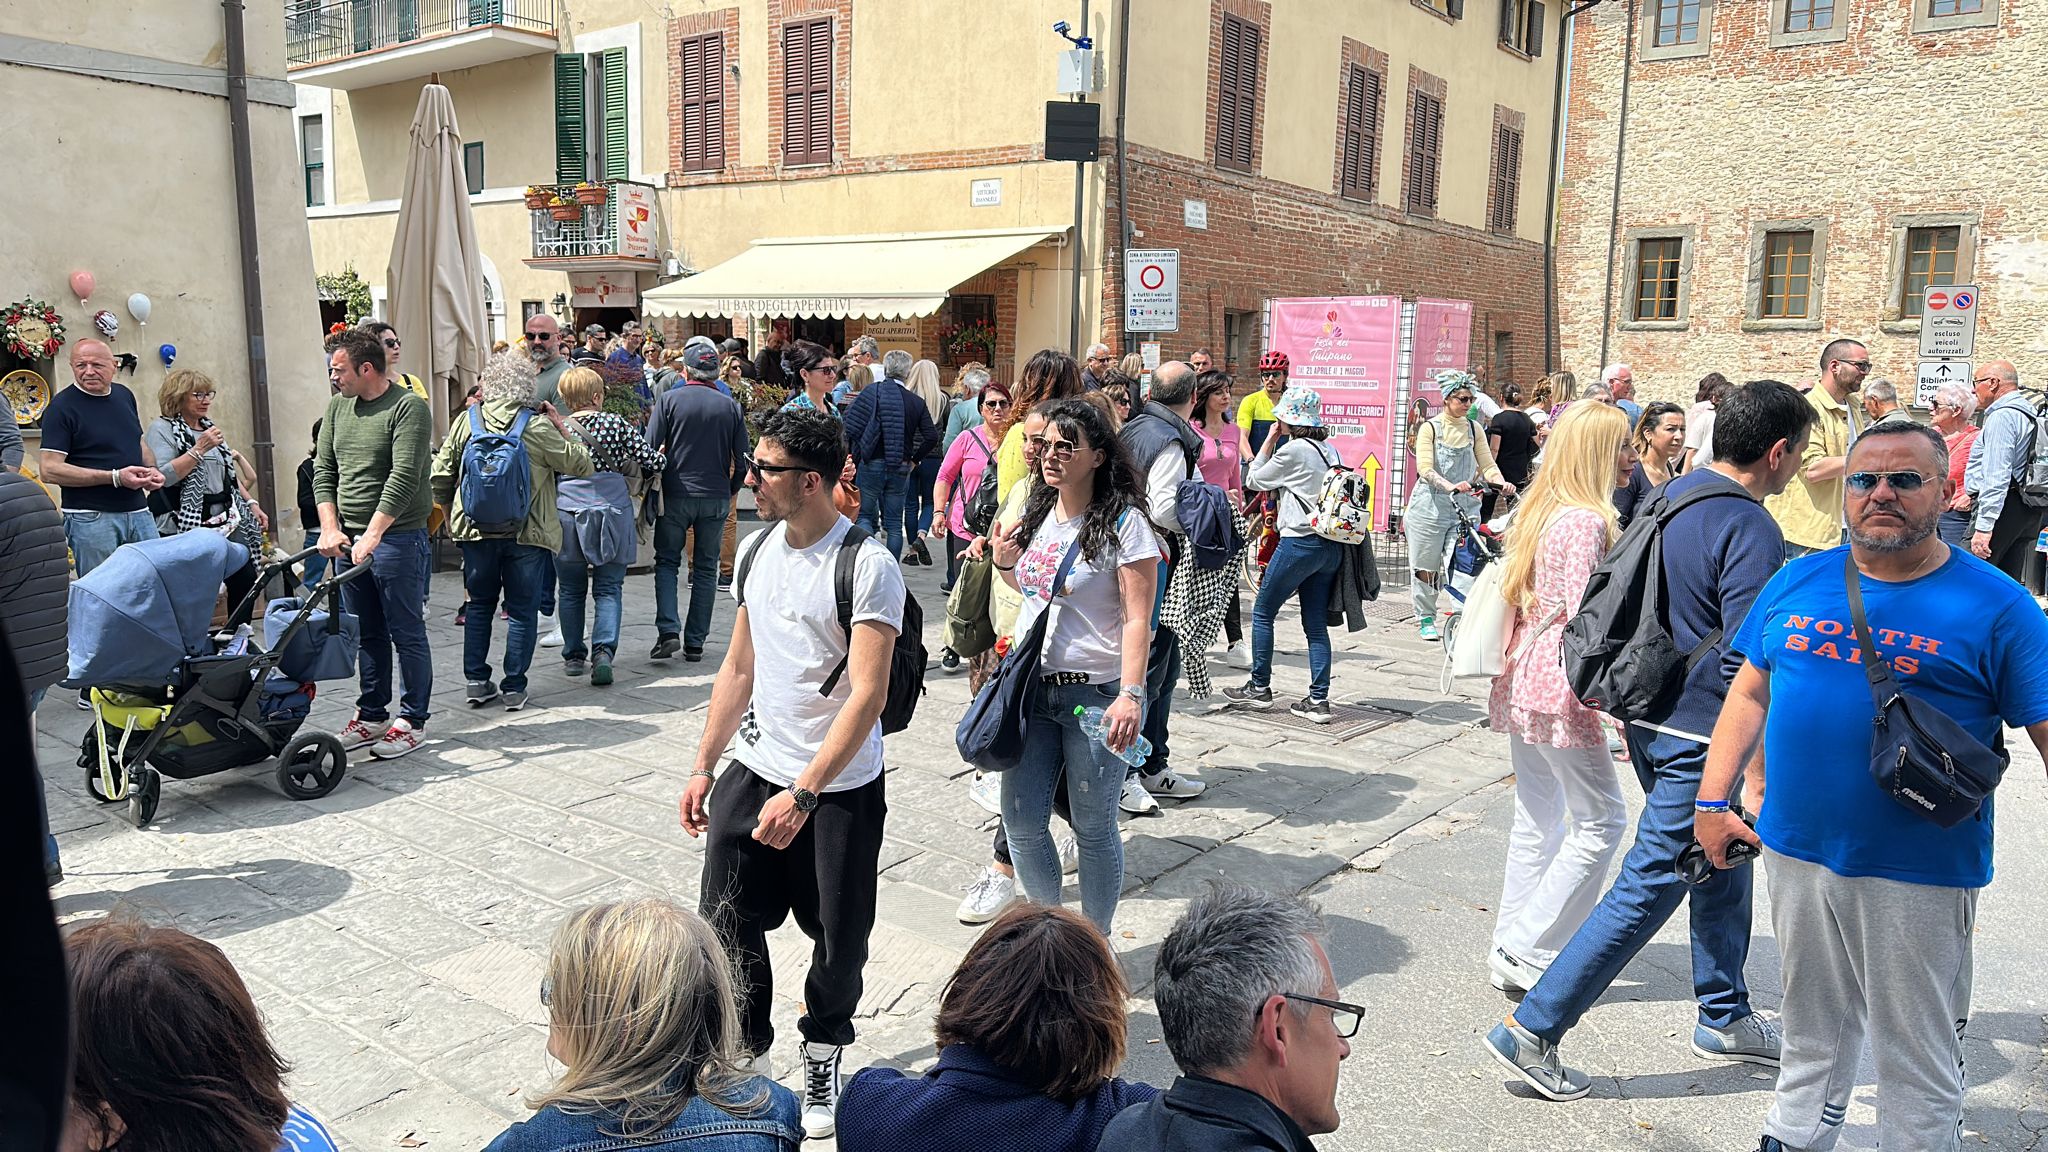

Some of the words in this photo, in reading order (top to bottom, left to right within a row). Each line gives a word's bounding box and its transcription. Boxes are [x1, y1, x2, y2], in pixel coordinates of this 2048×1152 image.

[733, 300, 756, 311] BAR
[758, 300, 791, 312] DEGLI
[793, 299, 852, 312] APERITIVI
[1314, 337, 1333, 348] Festa
[1310, 347, 1352, 362] Tulipano
[1314, 367, 1332, 375] APRILE
[1344, 367, 1365, 375] MAGGIO
[1325, 404, 1345, 416] CARRI
[1346, 405, 1384, 417] ALLEGORICI
[1337, 426, 1364, 435] NOTTURNA
[1785, 634, 1920, 675] SAIS
